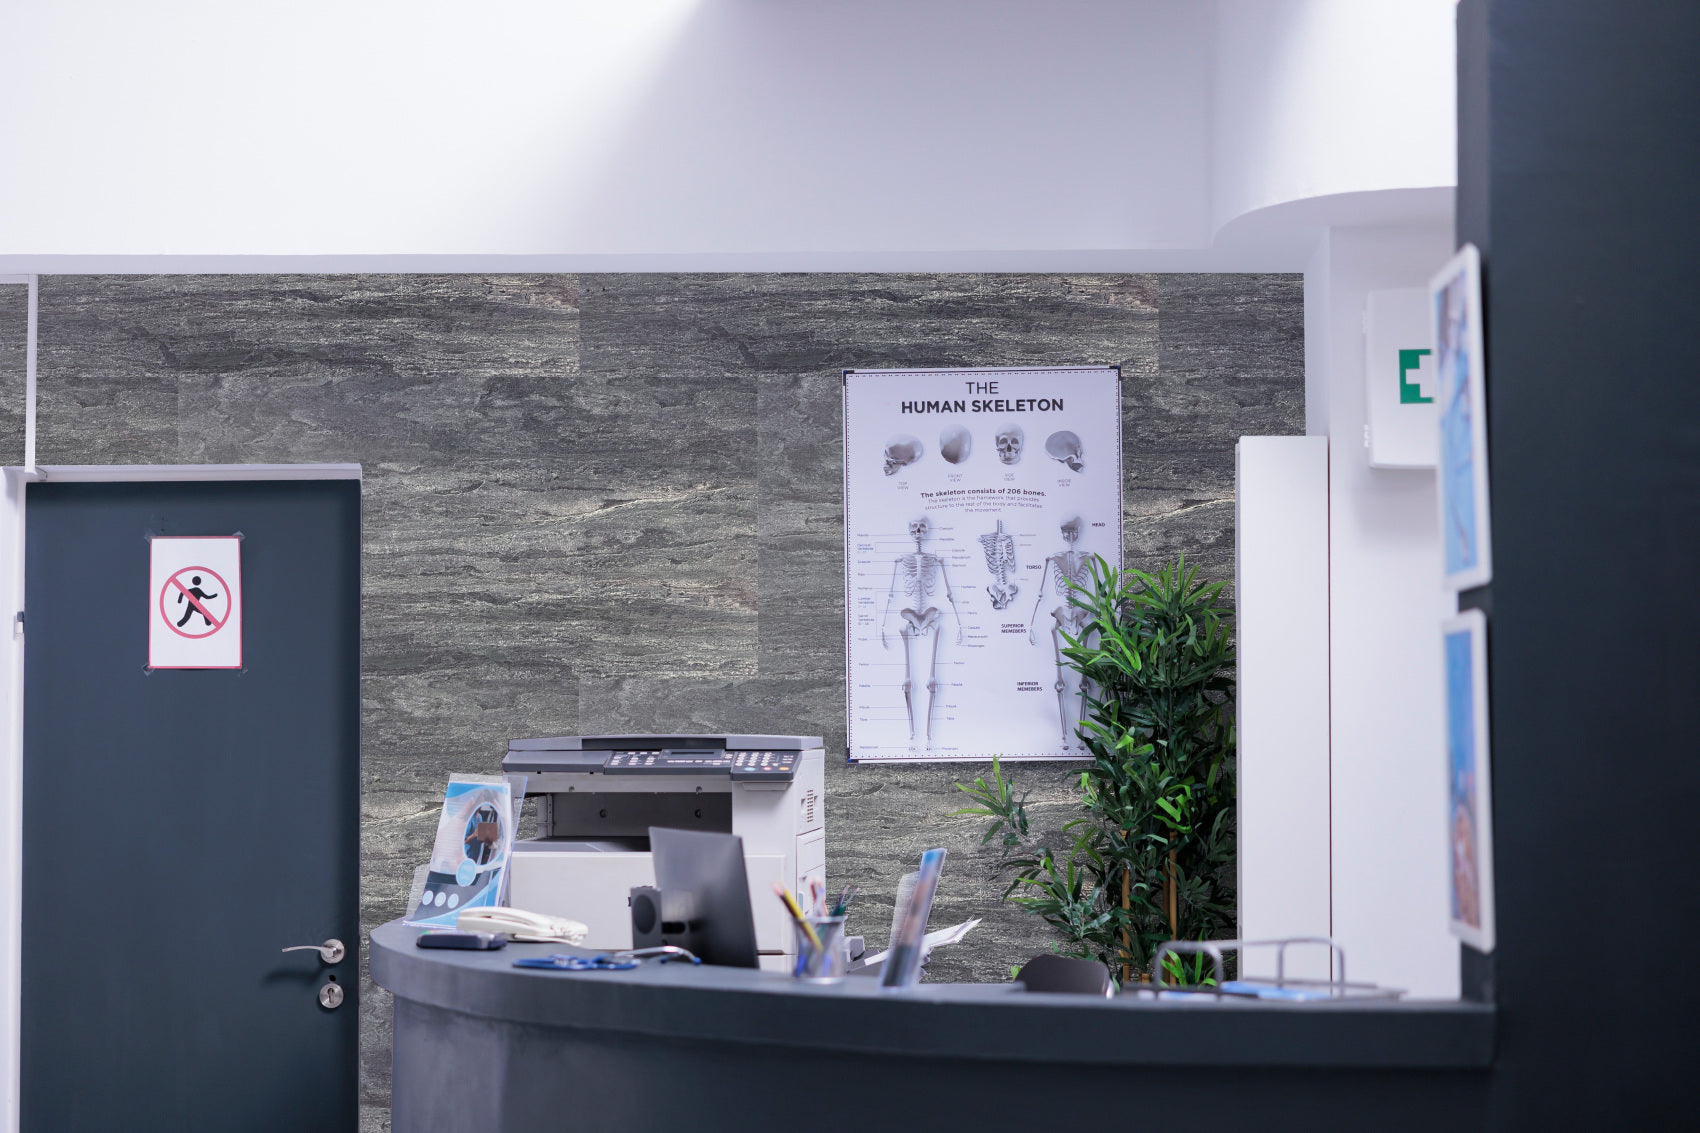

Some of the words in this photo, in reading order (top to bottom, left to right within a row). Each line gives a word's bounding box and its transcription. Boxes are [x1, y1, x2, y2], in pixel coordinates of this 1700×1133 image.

[965, 382, 999, 395] THE
[901, 400, 966, 414] HUMAN
[971, 398, 1064, 413] SKELETON
[935, 489, 966, 497] skeleton
[1023, 489, 1047, 497] bones.
[924, 503, 948, 511] structure
